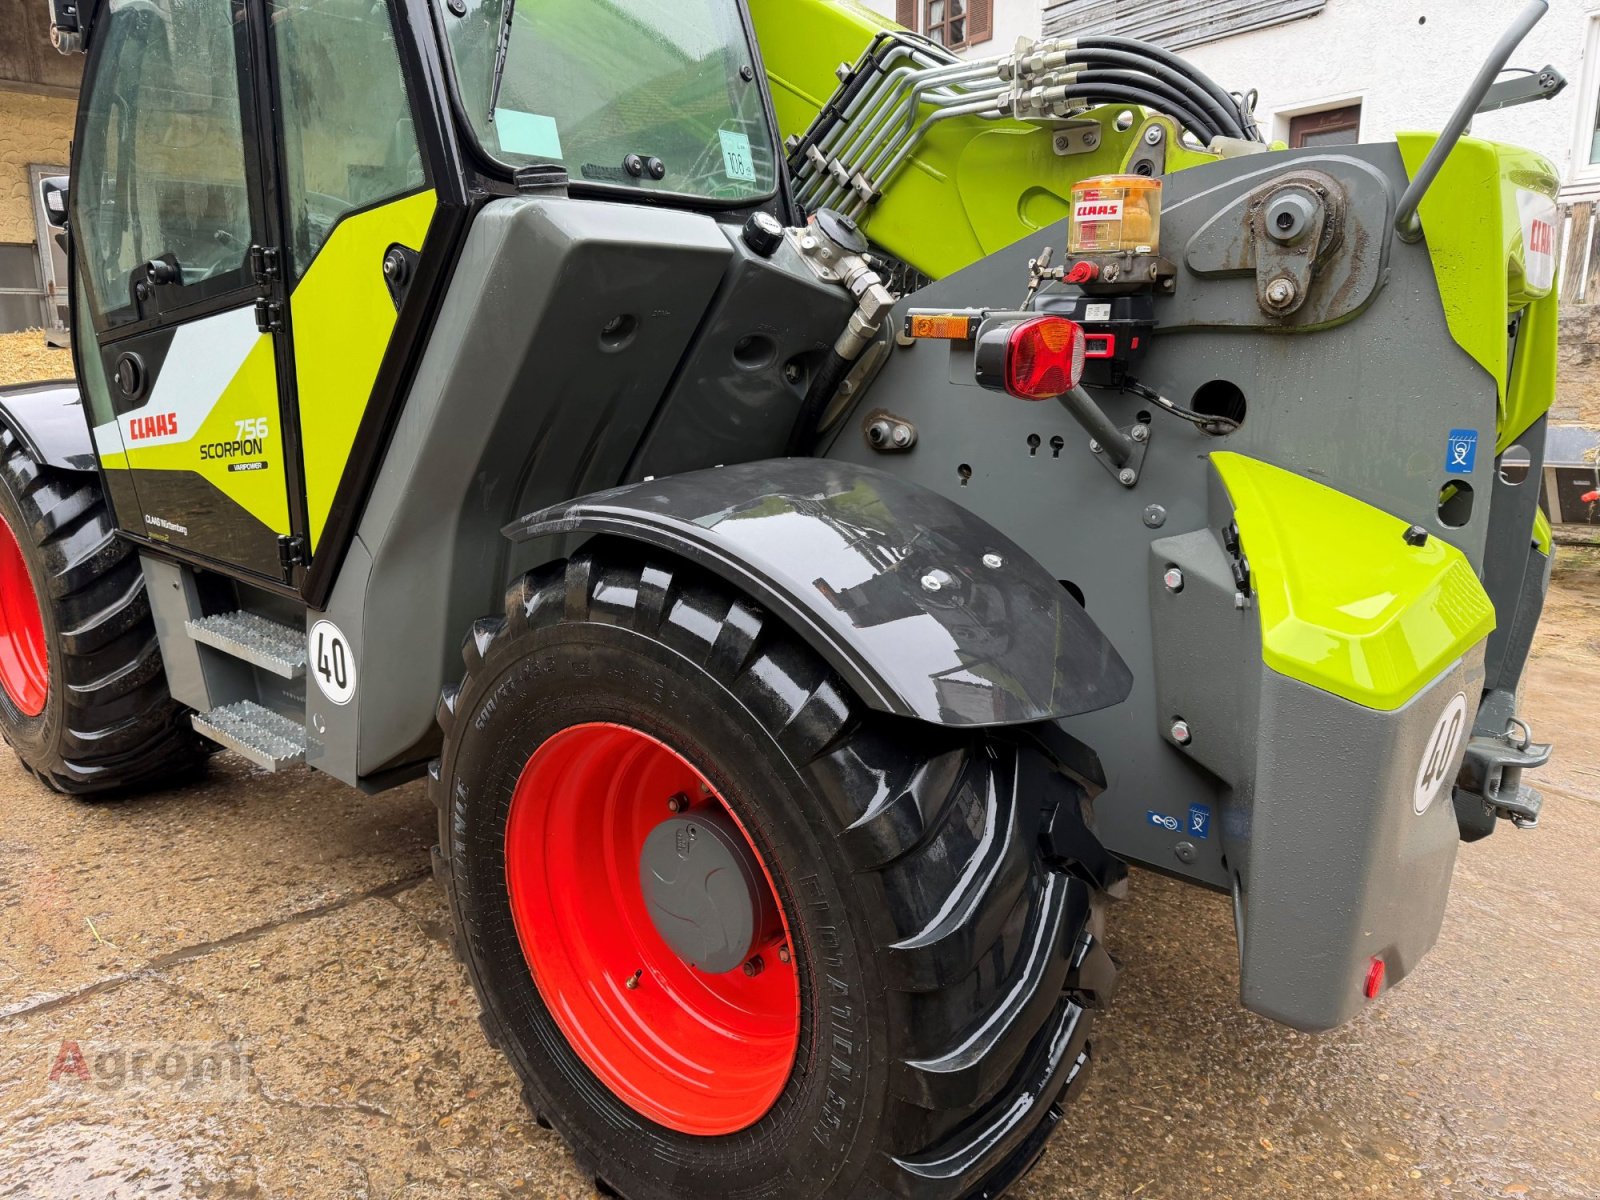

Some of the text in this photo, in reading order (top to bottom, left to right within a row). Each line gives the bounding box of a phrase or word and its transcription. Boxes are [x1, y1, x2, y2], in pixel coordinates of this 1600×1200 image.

[727, 152, 745, 175] 108
[1077, 205, 1118, 216] CLAAS
[129, 412, 178, 440] CLAAS
[234, 417, 269, 440] 756
[200, 438, 263, 460] SCORPION
[145, 514, 161, 527] CLAAS
[318, 632, 347, 690] 40
[1420, 708, 1462, 792] 40
